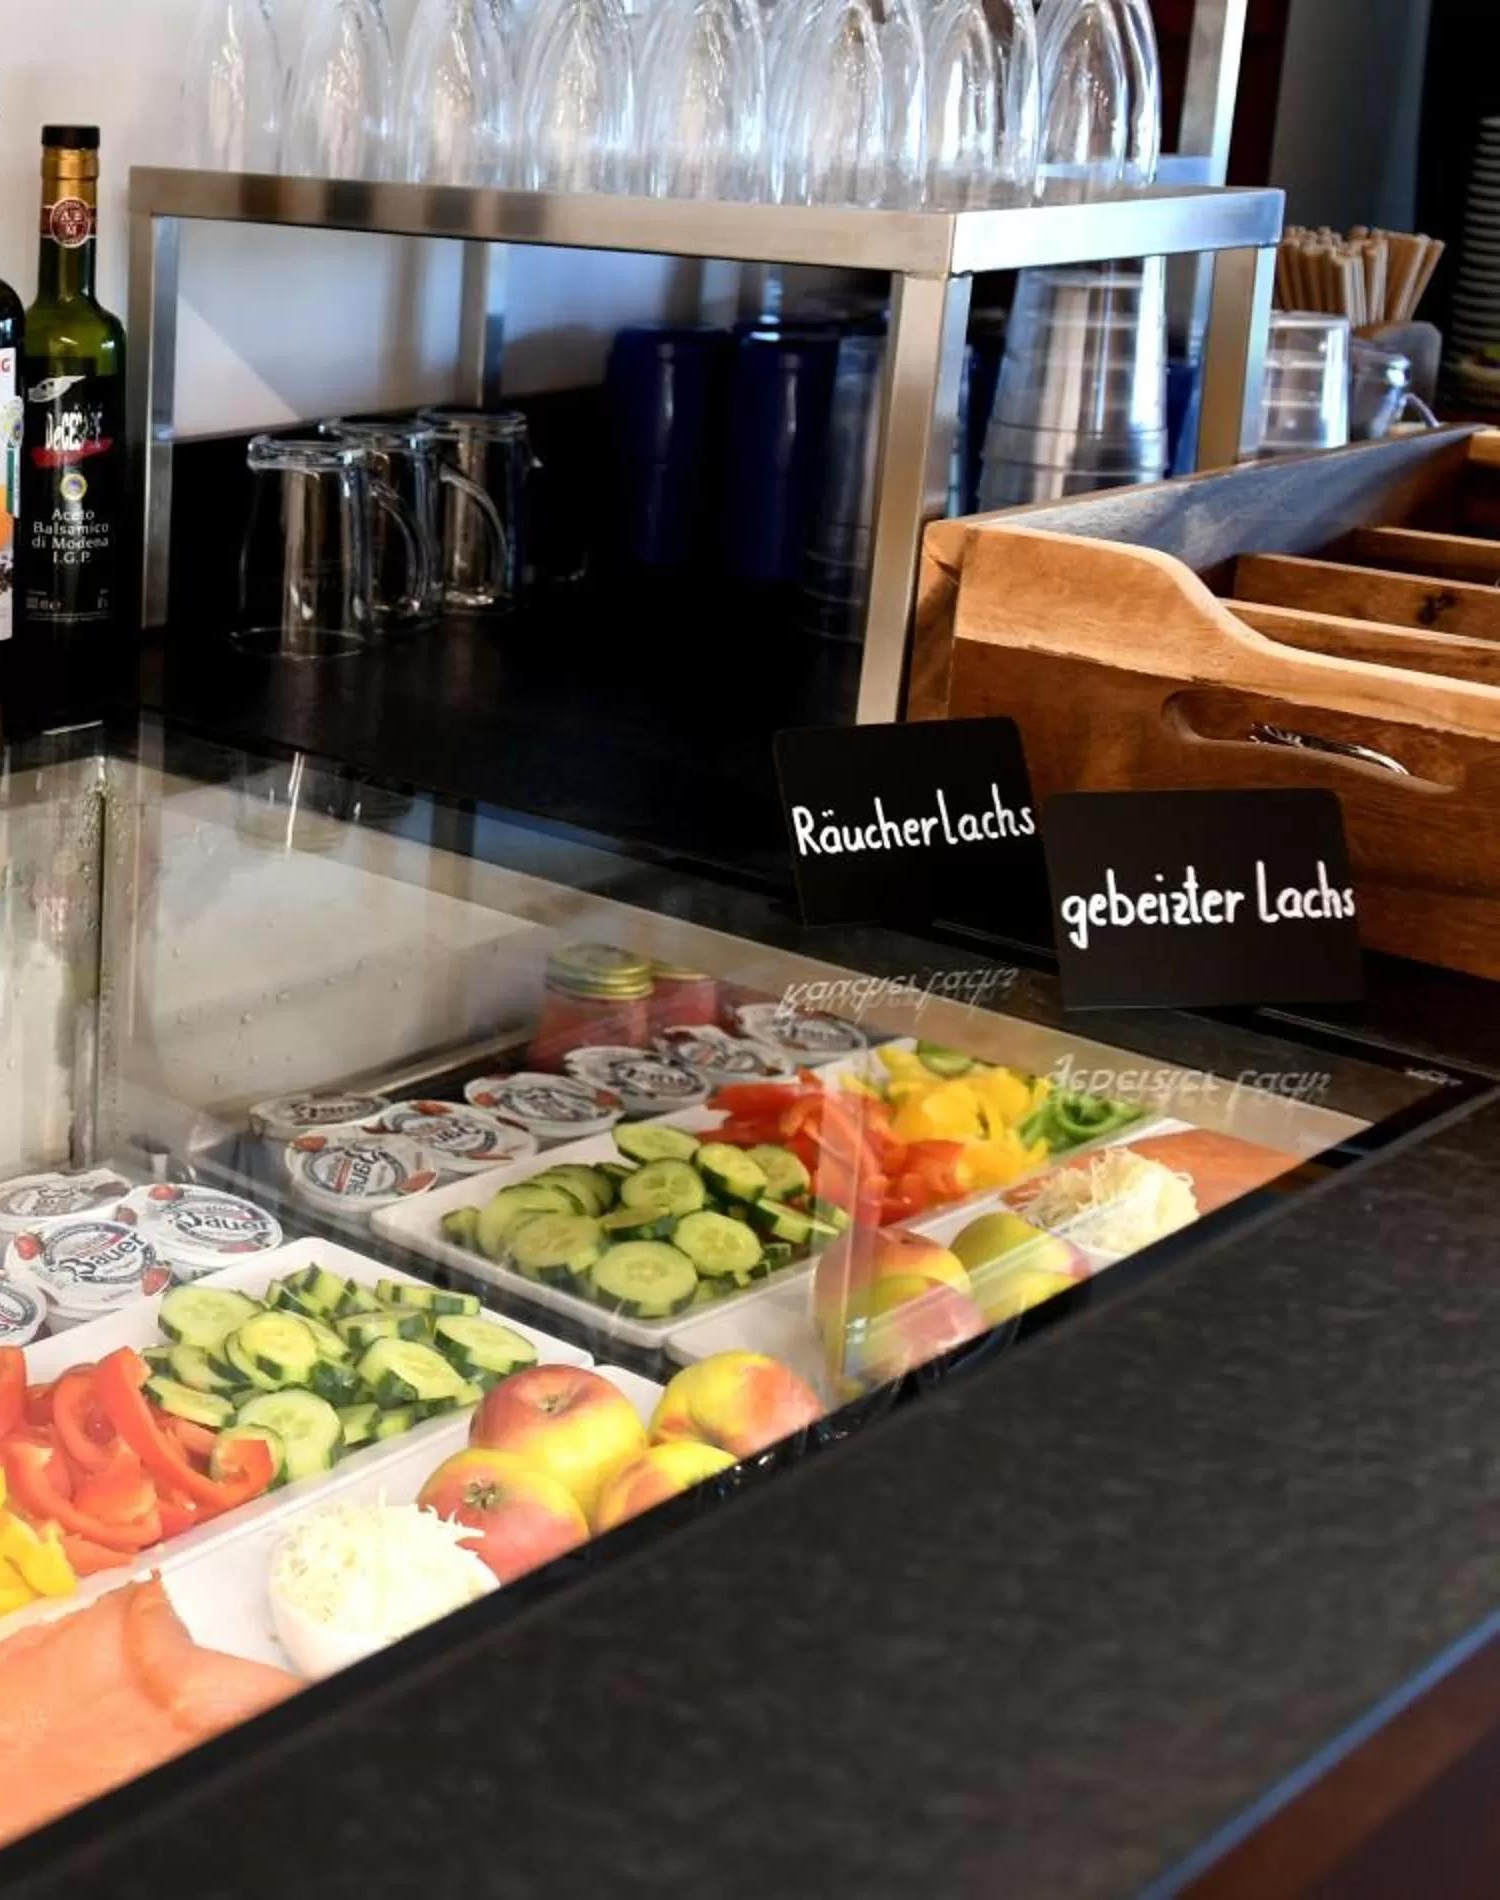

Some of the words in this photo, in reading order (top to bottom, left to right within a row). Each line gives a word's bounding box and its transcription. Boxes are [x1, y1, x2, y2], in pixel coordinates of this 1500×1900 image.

[33, 521, 110, 536] Balsamico
[51, 508, 96, 521] Aceto
[31, 536, 47, 549] di
[51, 537, 109, 550] Modena
[791, 783, 1036, 857] Räucherlachs
[1061, 865, 1245, 949] gebeizter
[1255, 860, 1356, 923] Lachs
[56, 1232, 146, 1282] Bauer
